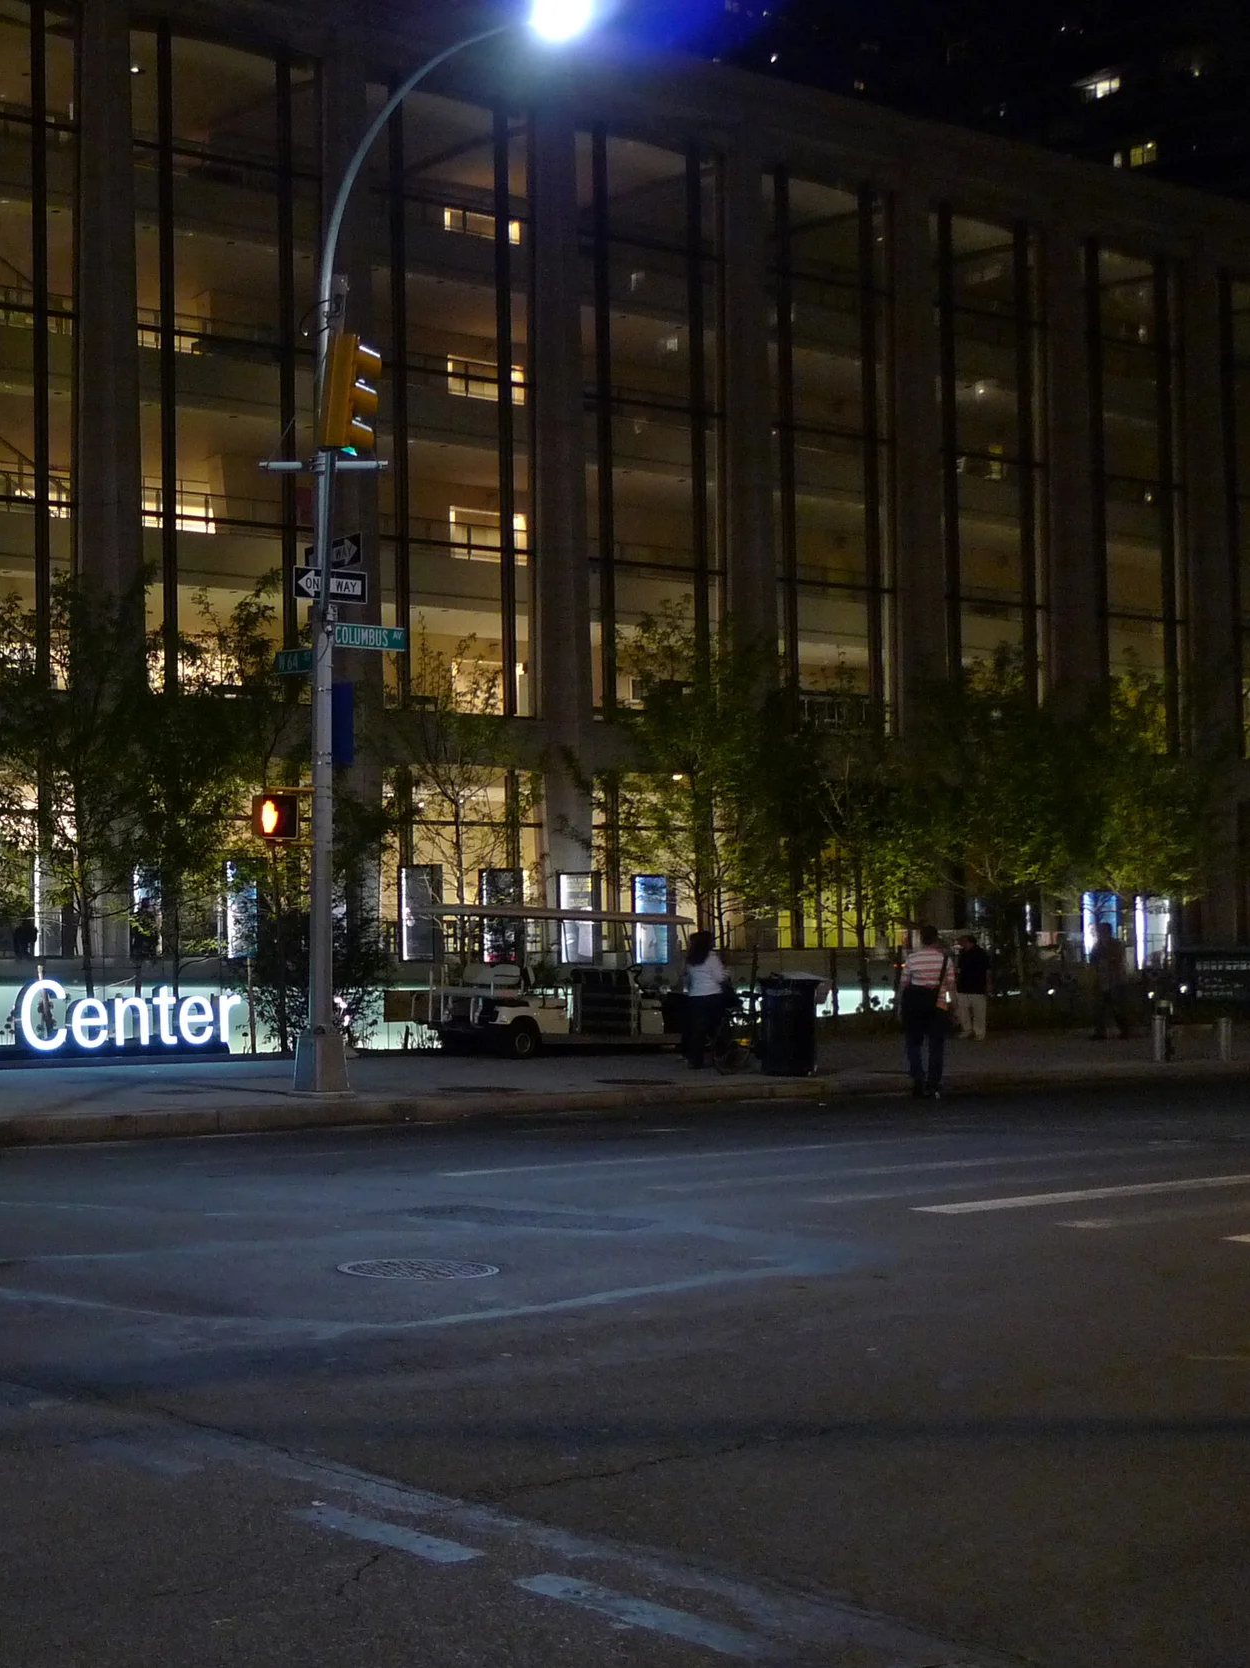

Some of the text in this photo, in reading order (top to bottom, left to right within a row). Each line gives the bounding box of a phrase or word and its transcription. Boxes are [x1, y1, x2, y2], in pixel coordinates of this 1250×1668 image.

[335, 545, 353, 559] WAY
[305, 577, 357, 593] ON WAY
[335, 626, 389, 647] COLUMBUS
[20, 979, 242, 1051] Center
